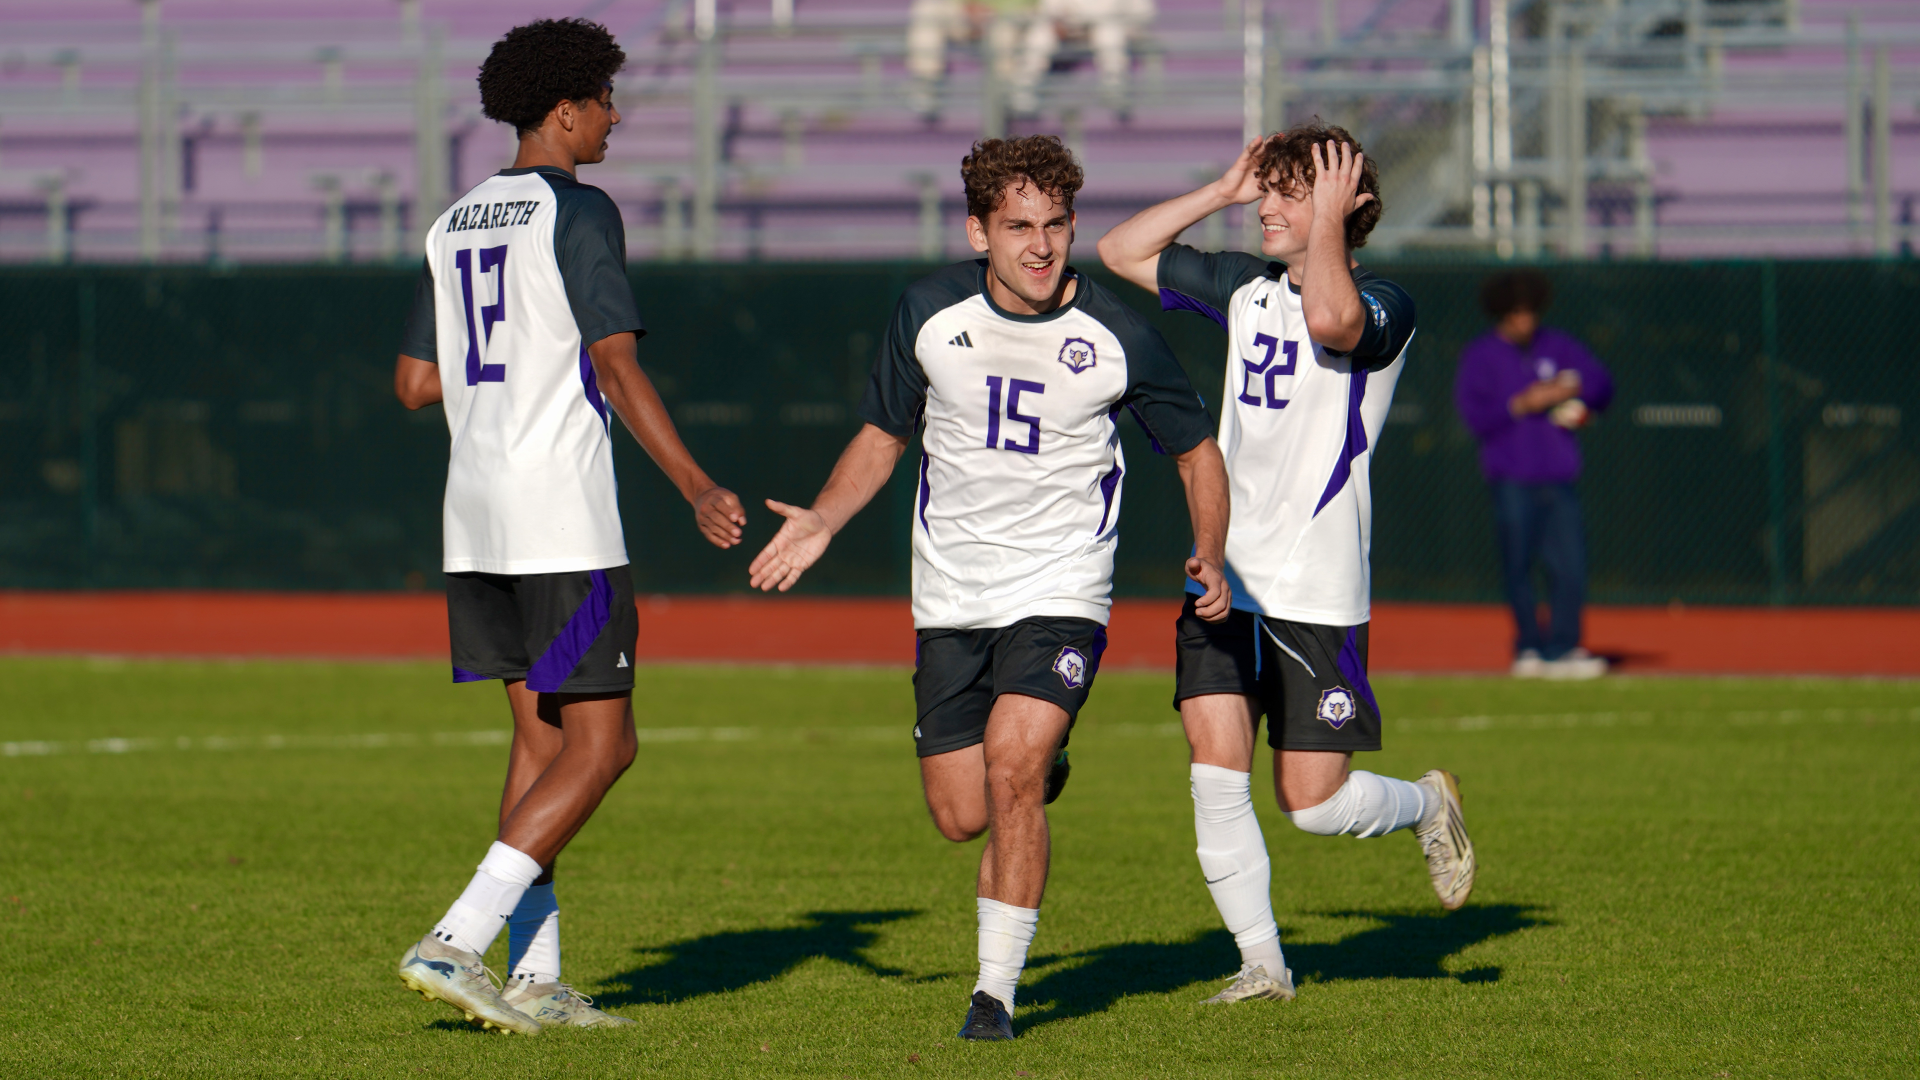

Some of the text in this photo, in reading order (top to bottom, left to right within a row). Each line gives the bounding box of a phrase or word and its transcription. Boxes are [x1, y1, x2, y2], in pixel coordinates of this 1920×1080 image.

[446, 200, 541, 233] NAZARETH
[455, 244, 508, 386] 12
[1238, 332, 1299, 409] 22
[986, 375, 1046, 455] 15
